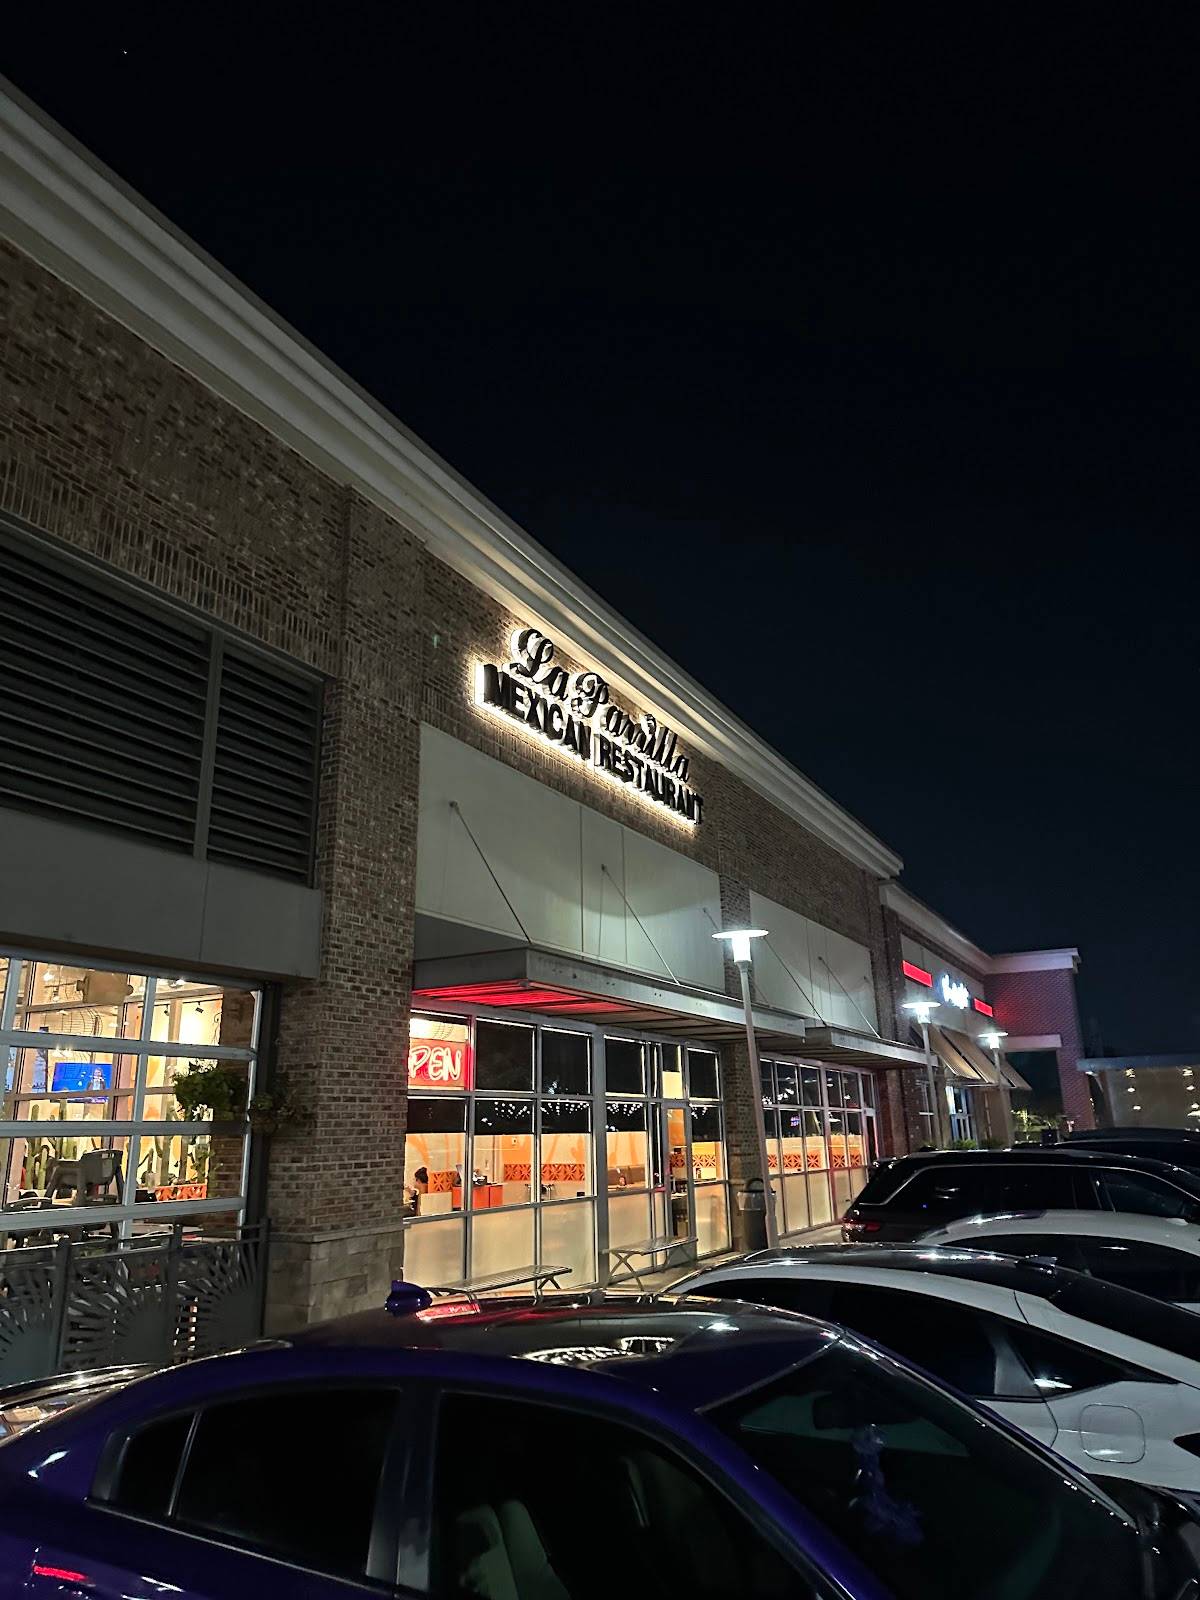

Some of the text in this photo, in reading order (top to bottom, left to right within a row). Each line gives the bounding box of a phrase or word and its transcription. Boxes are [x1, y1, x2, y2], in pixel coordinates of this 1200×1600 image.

[479, 663, 704, 825] MEXICAN RESTAURANT
[508, 628, 690, 783] La Parrilla
[407, 1045, 462, 1081] PEN
